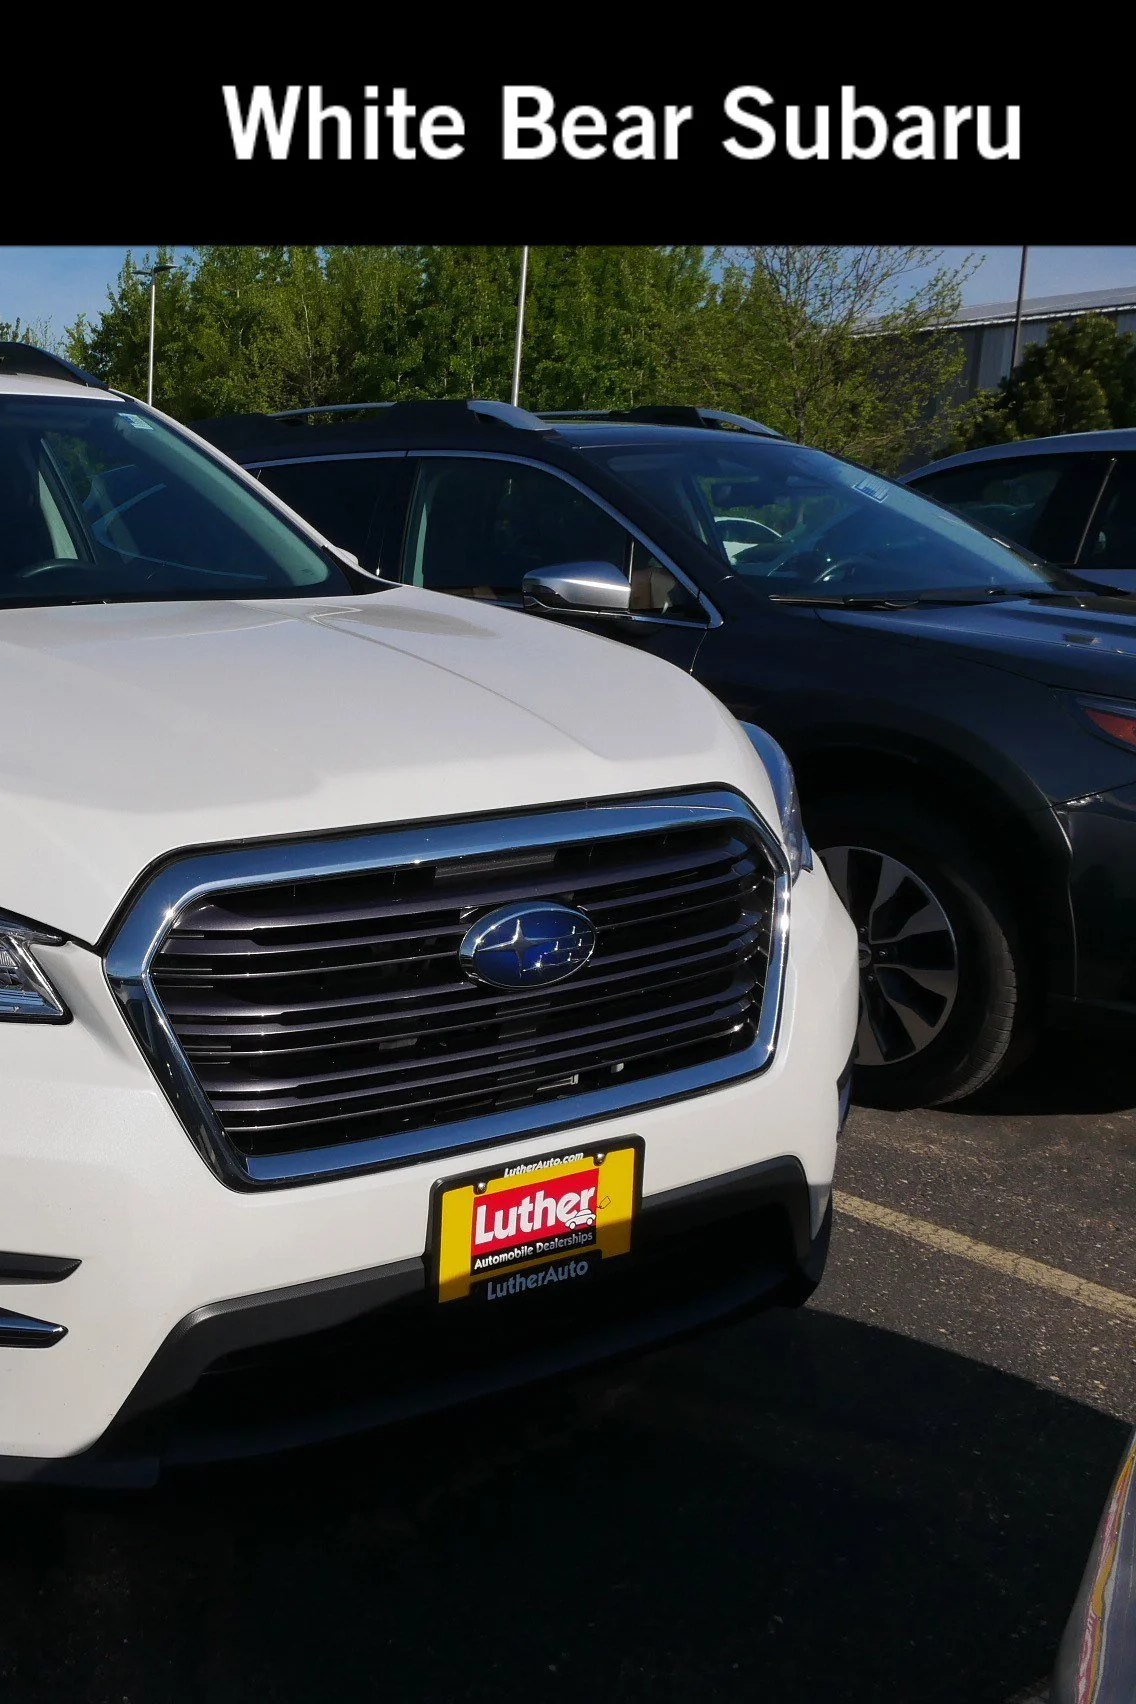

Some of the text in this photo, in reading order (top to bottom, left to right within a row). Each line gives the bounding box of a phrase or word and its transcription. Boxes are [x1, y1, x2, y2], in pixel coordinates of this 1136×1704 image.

[504, 1152, 584, 1178] LutherAuto.com
[475, 1186, 596, 1245] Luther
[474, 1231, 593, 1270] Automobile Dealerships
[487, 1260, 589, 1301] LutherAuto
